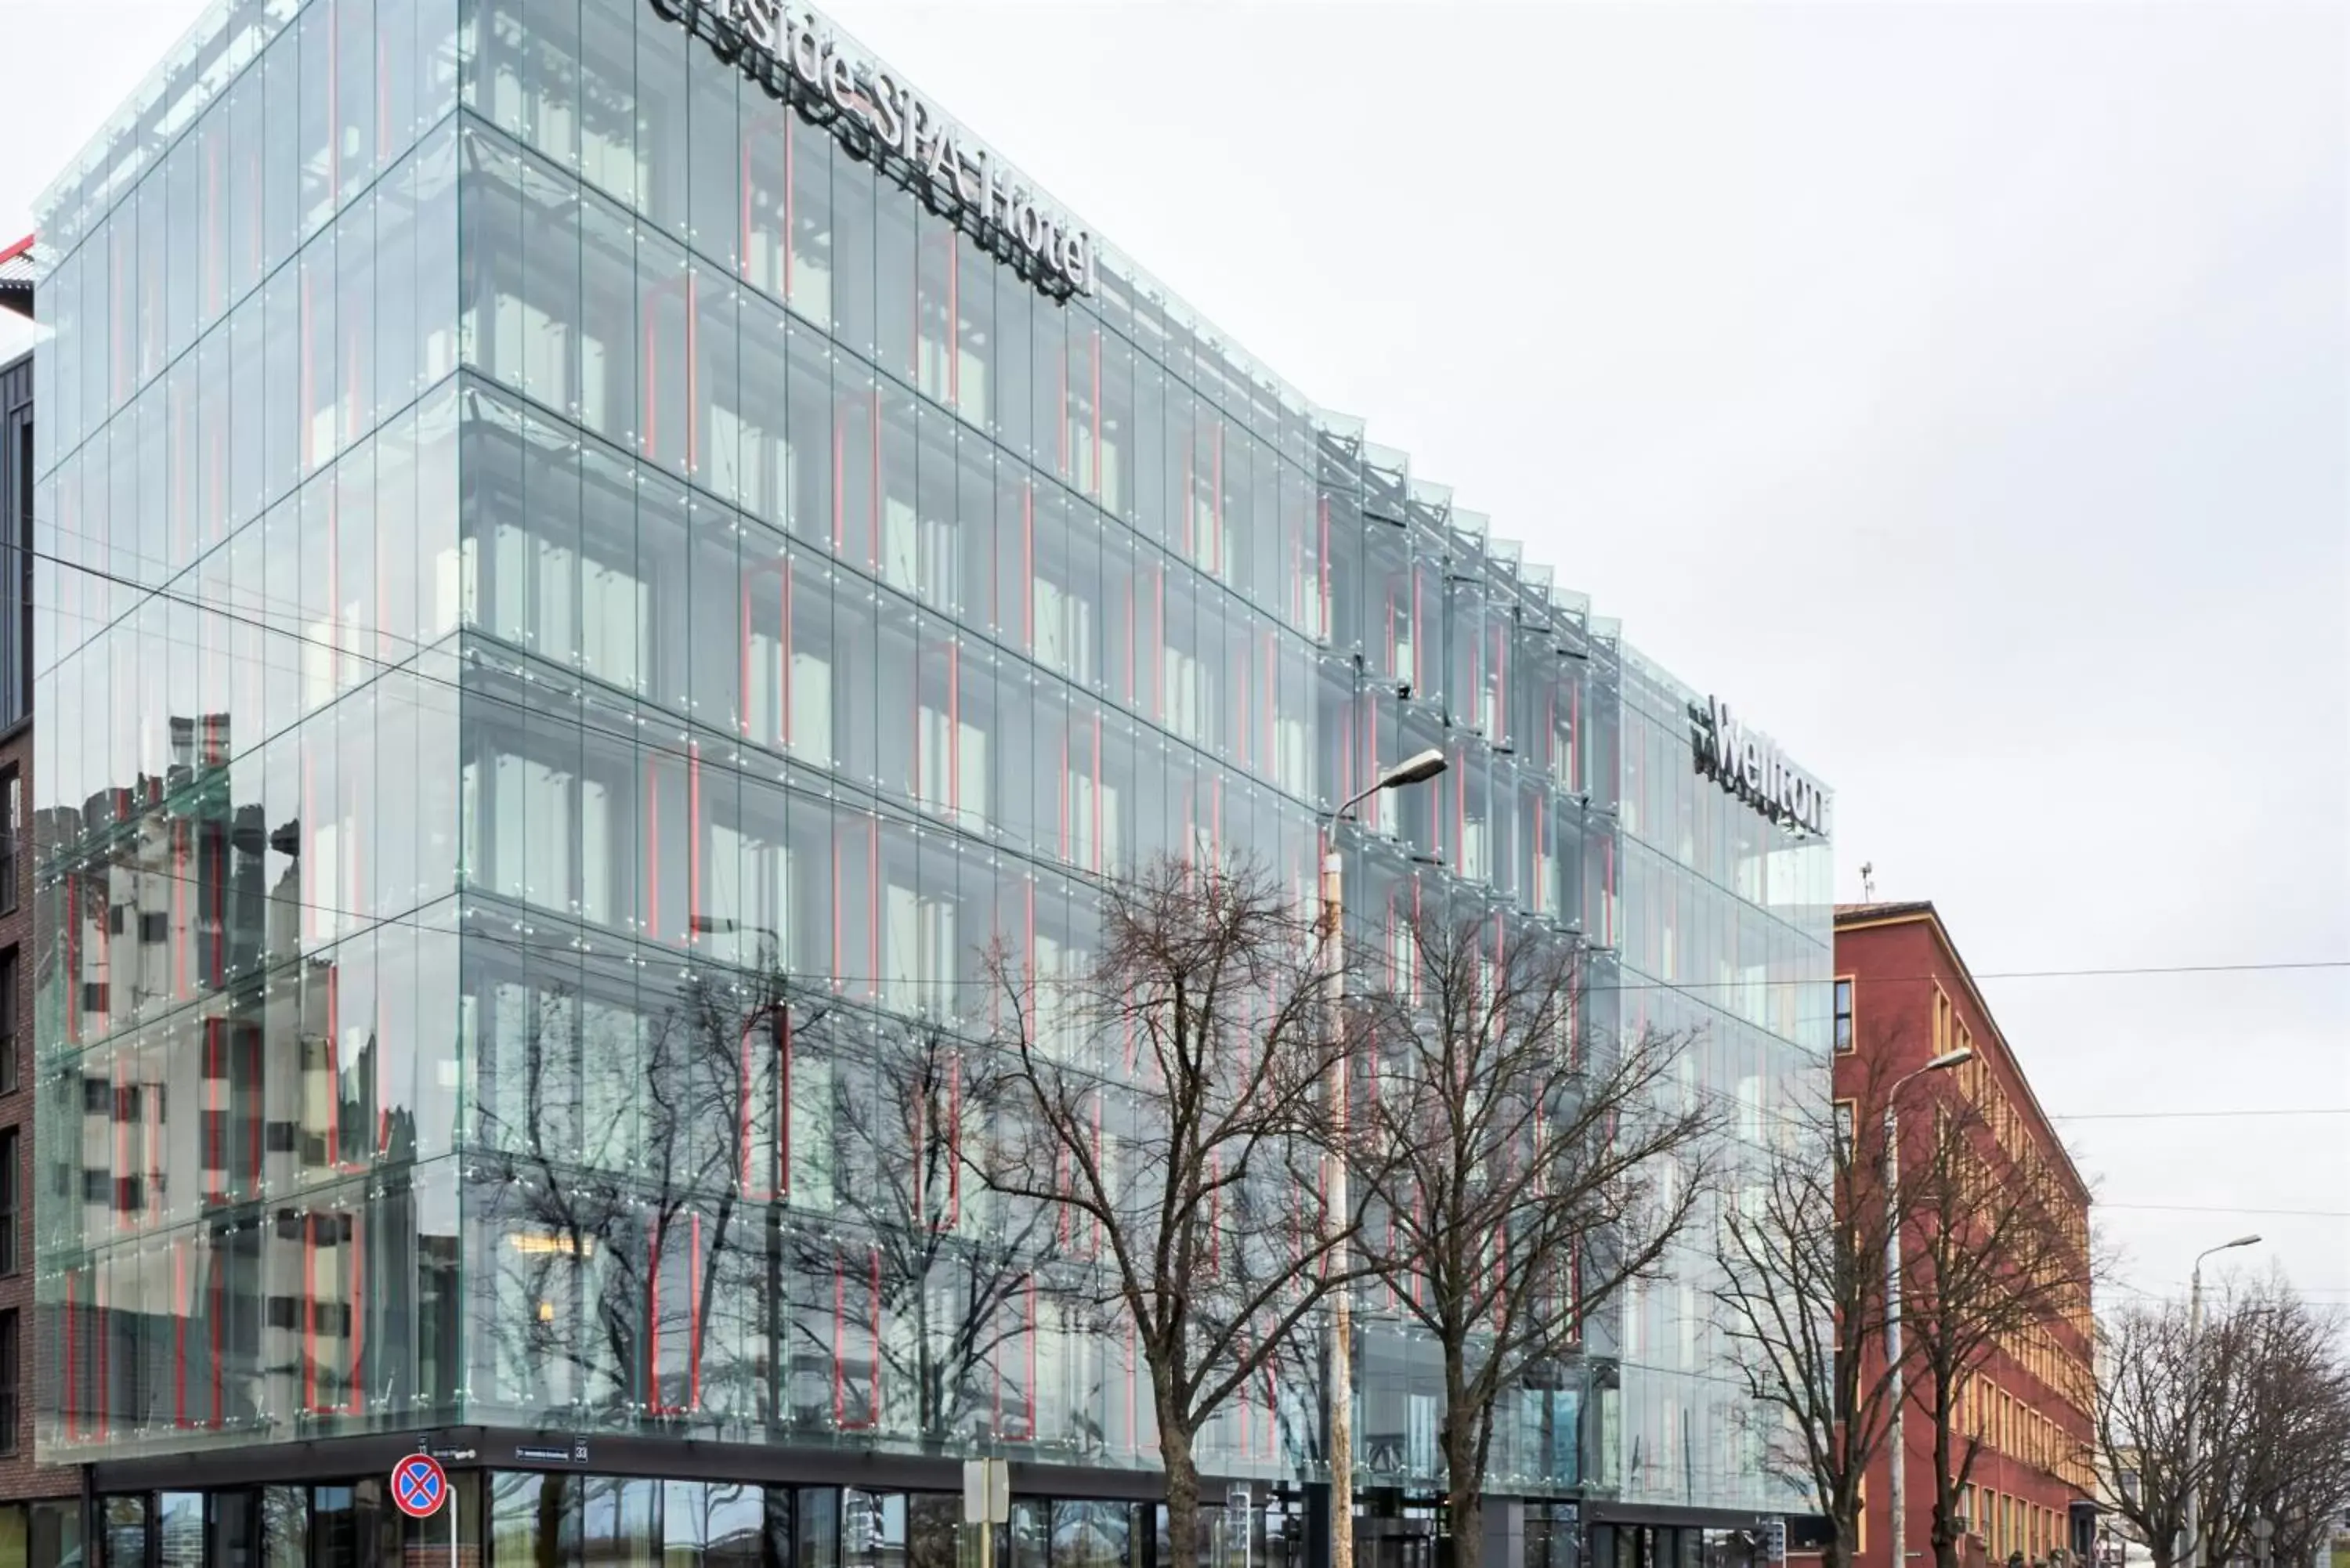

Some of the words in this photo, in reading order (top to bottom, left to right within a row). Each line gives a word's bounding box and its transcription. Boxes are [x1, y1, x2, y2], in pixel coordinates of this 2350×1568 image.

[869, 69, 974, 202] SPA
[978, 150, 1094, 296] Hotel
[1708, 694, 1821, 833] Wellton
